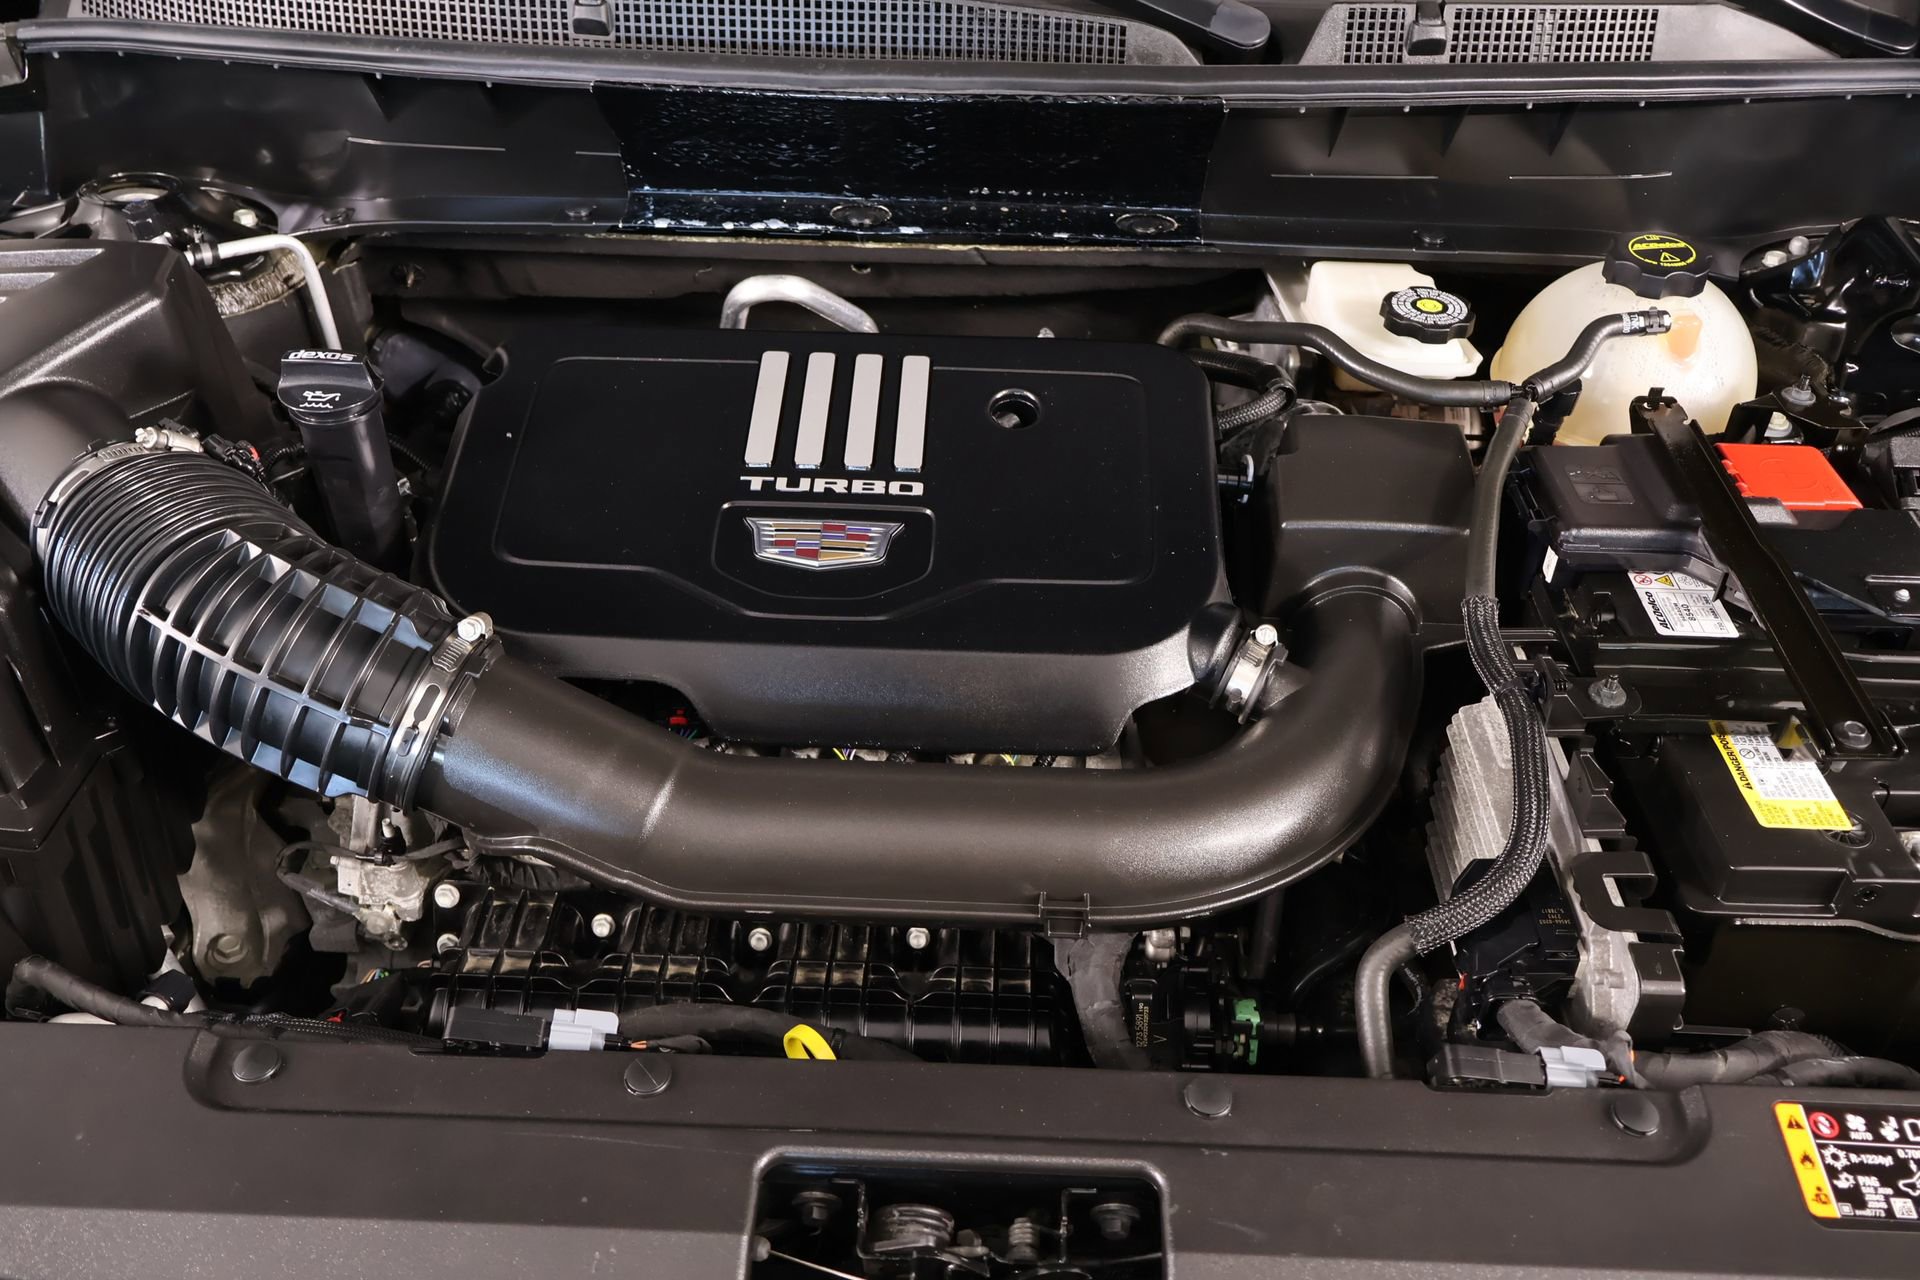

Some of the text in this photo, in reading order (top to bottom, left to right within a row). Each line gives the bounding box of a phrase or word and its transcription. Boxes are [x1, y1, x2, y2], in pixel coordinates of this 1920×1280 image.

[288, 350, 356, 361] dexos
[740, 476, 924, 496] TURBO
[1645, 591, 1670, 630] ACDelco
[1849, 1131, 1873, 1140] AUTO
[1896, 1148, 1920, 1159] 0.70
[1848, 1153, 1894, 1167] R-1234yf
[1856, 1175, 1880, 1187] PAG
